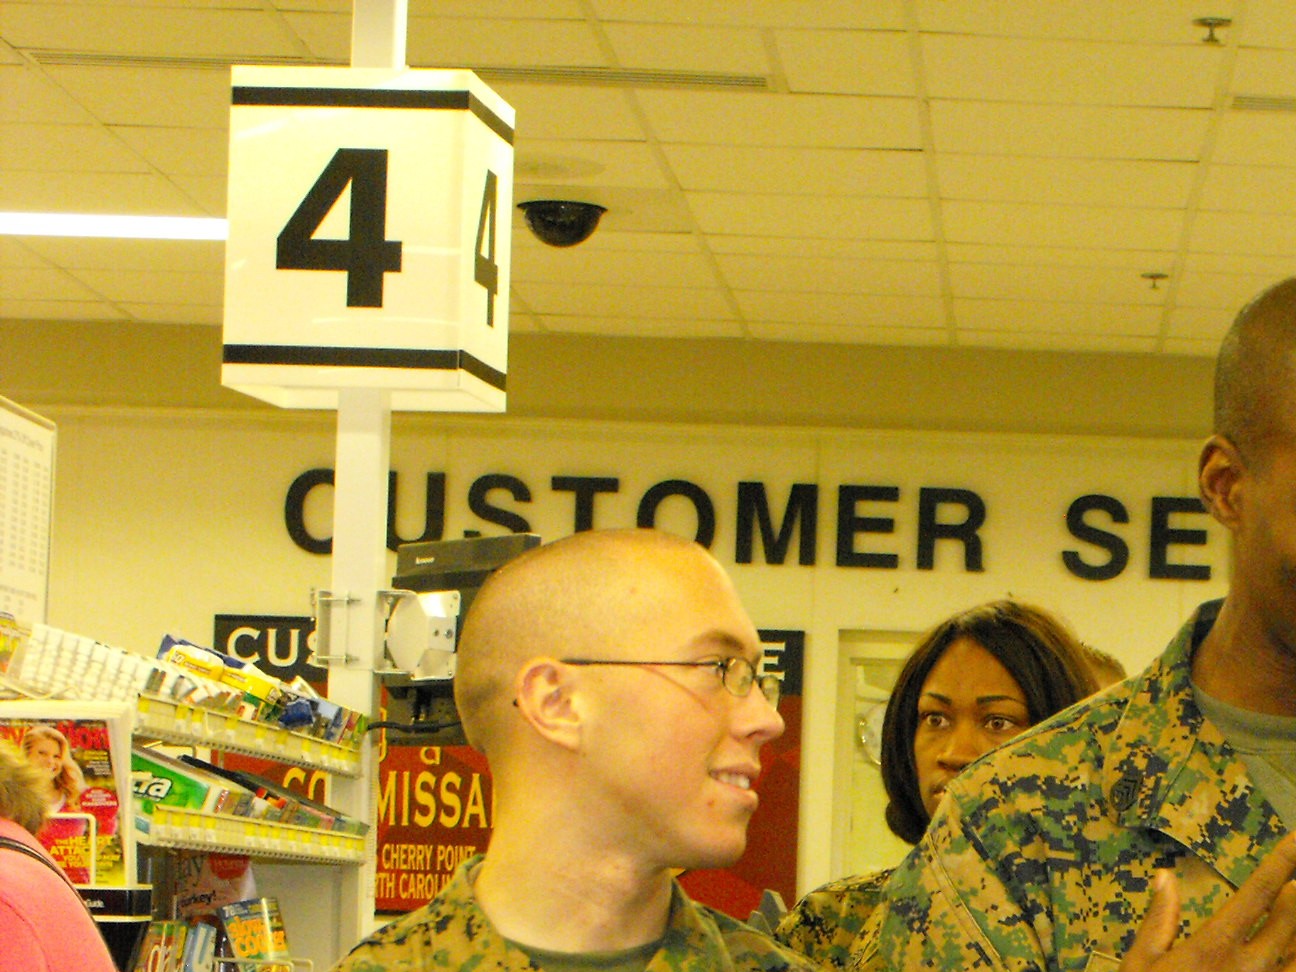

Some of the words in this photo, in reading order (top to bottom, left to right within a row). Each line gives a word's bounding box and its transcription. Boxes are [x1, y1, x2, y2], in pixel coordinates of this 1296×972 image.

[276, 148, 402, 308] 4
[474, 169, 498, 328] 4
[382, 843, 433, 871] CHERRY
